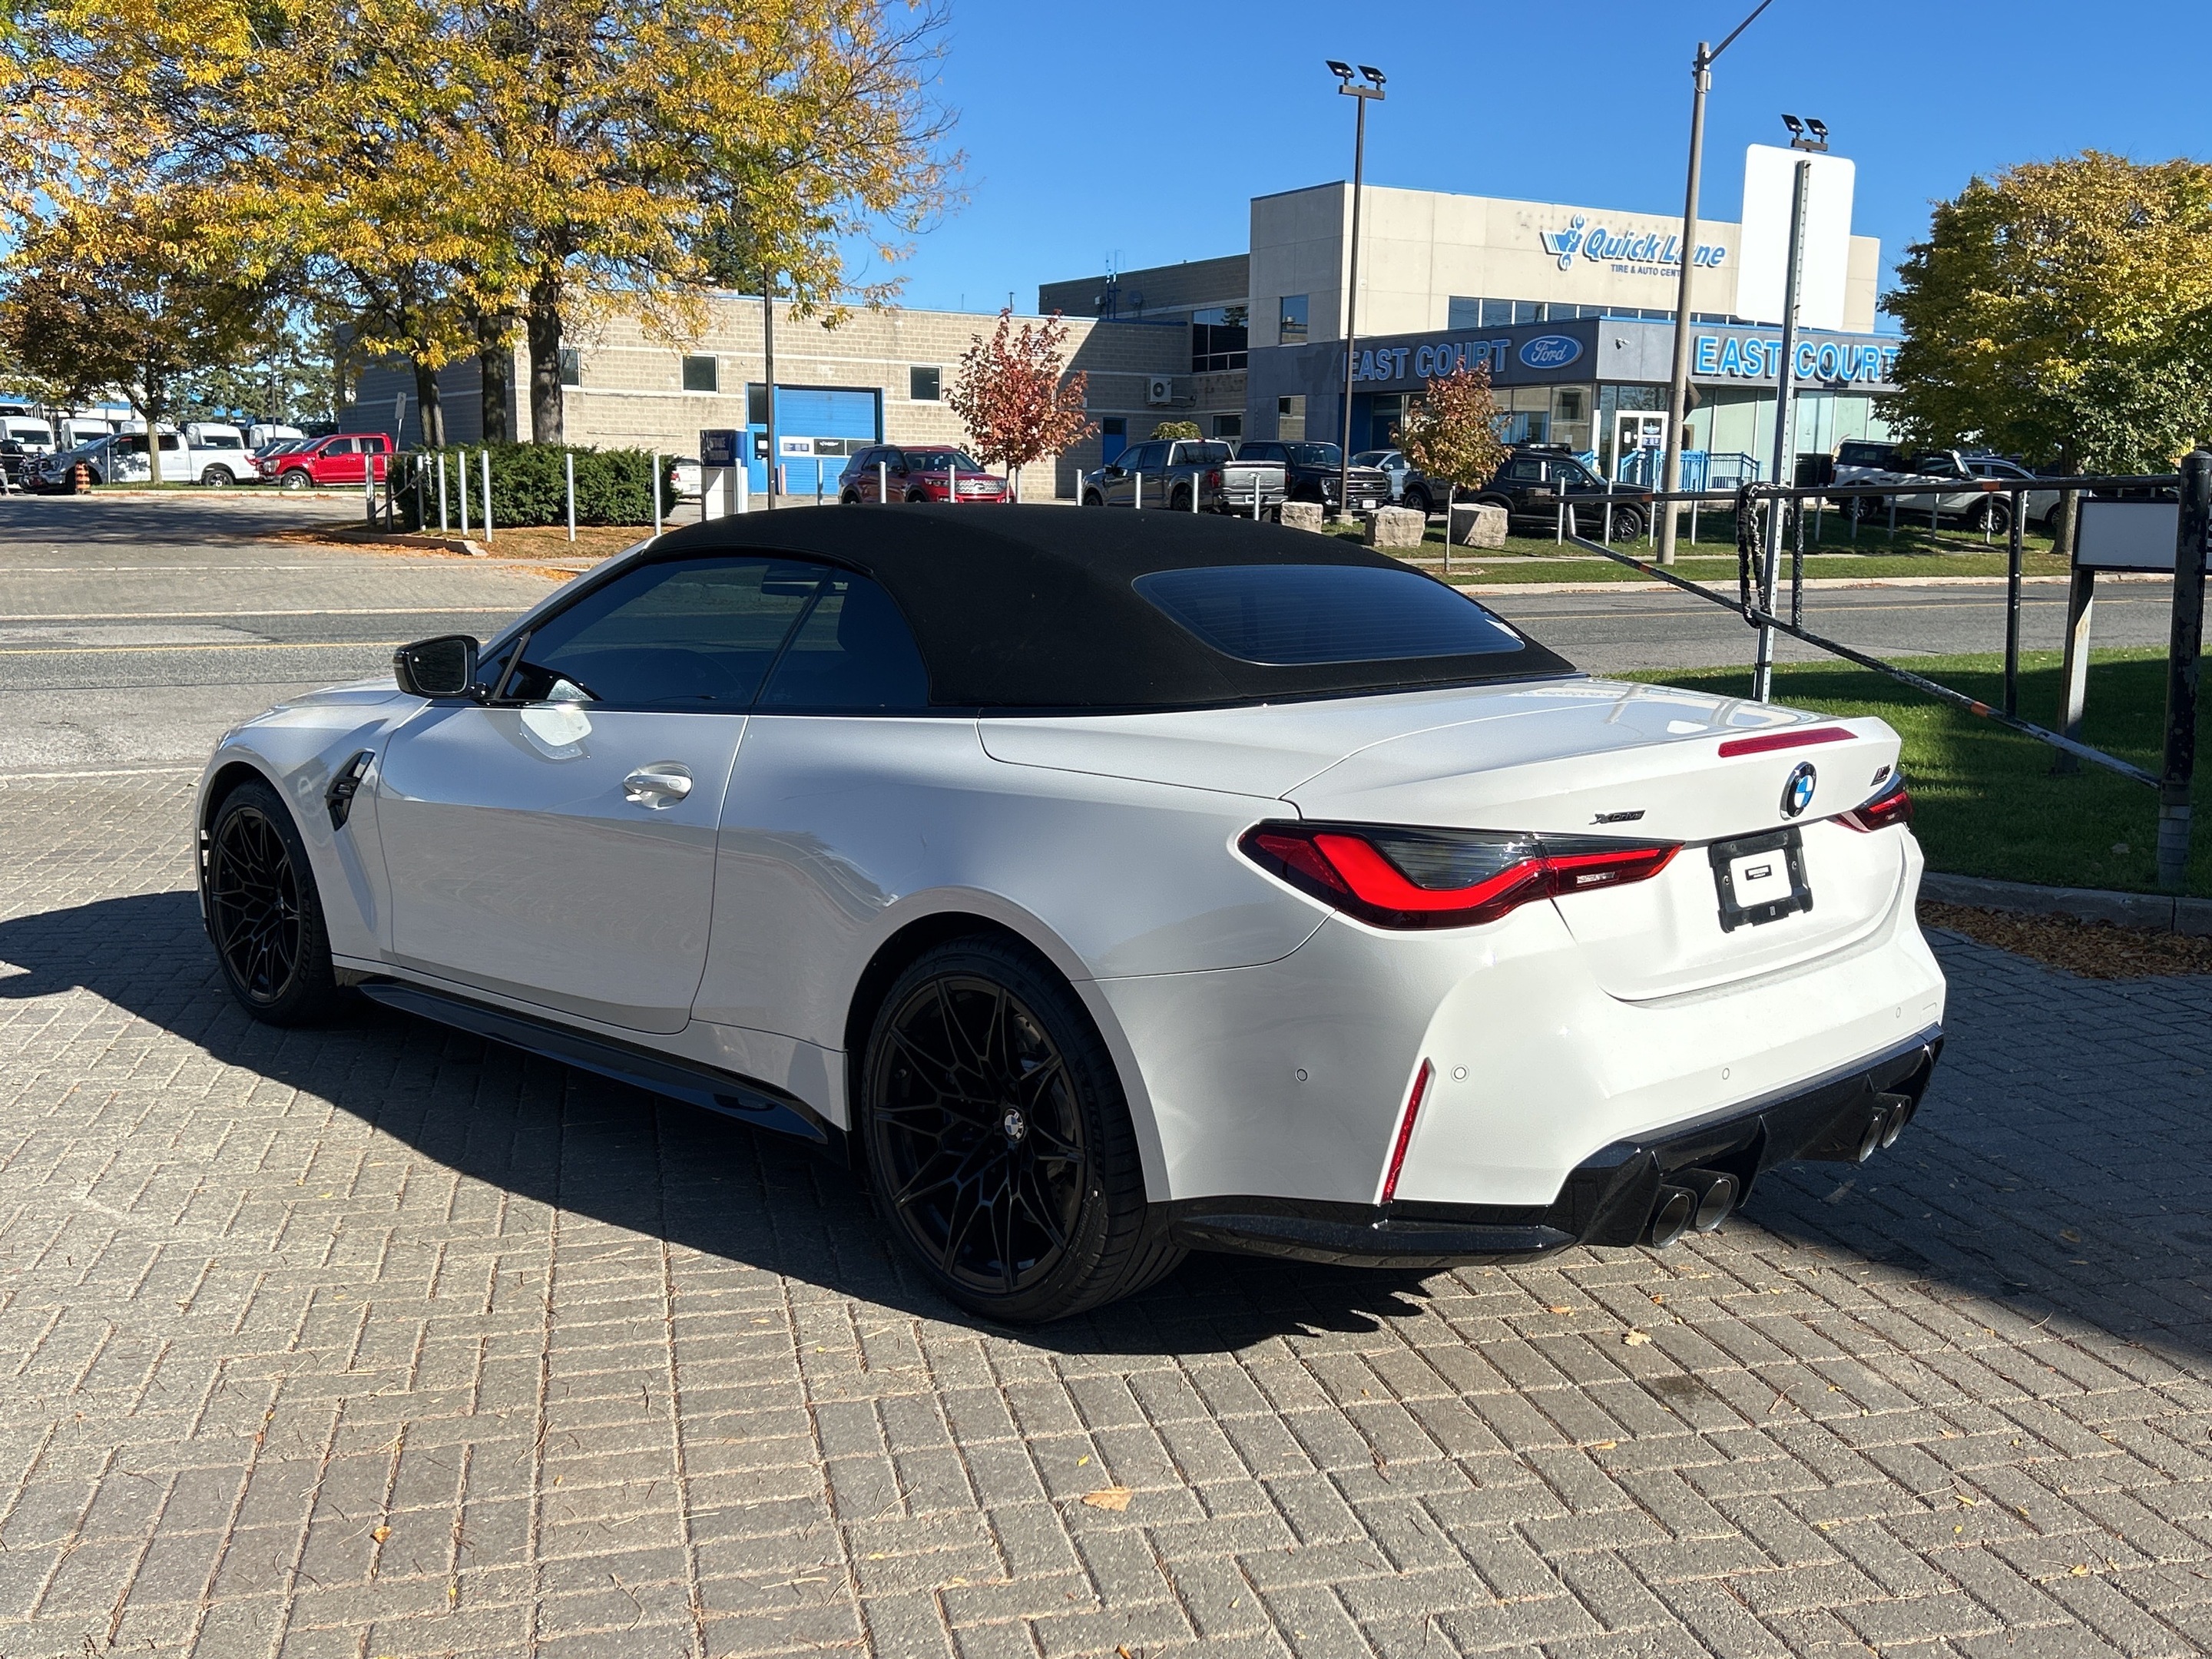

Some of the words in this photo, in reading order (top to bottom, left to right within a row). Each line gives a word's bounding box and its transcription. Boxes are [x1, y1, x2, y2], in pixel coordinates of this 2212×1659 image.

[1584, 227, 1661, 261] Quick
[1659, 234, 1727, 267] Lne
[1611, 264, 1629, 273] TIRE
[1637, 266, 1659, 276] AUTO
[1661, 268, 1681, 277] CENT
[1343, 347, 1410, 382] EAST
[1415, 339, 1512, 379] COURT
[1531, 339, 1567, 363] Ford
[1693, 335, 1782, 377] EAST
[1793, 340, 1902, 382] COURT
